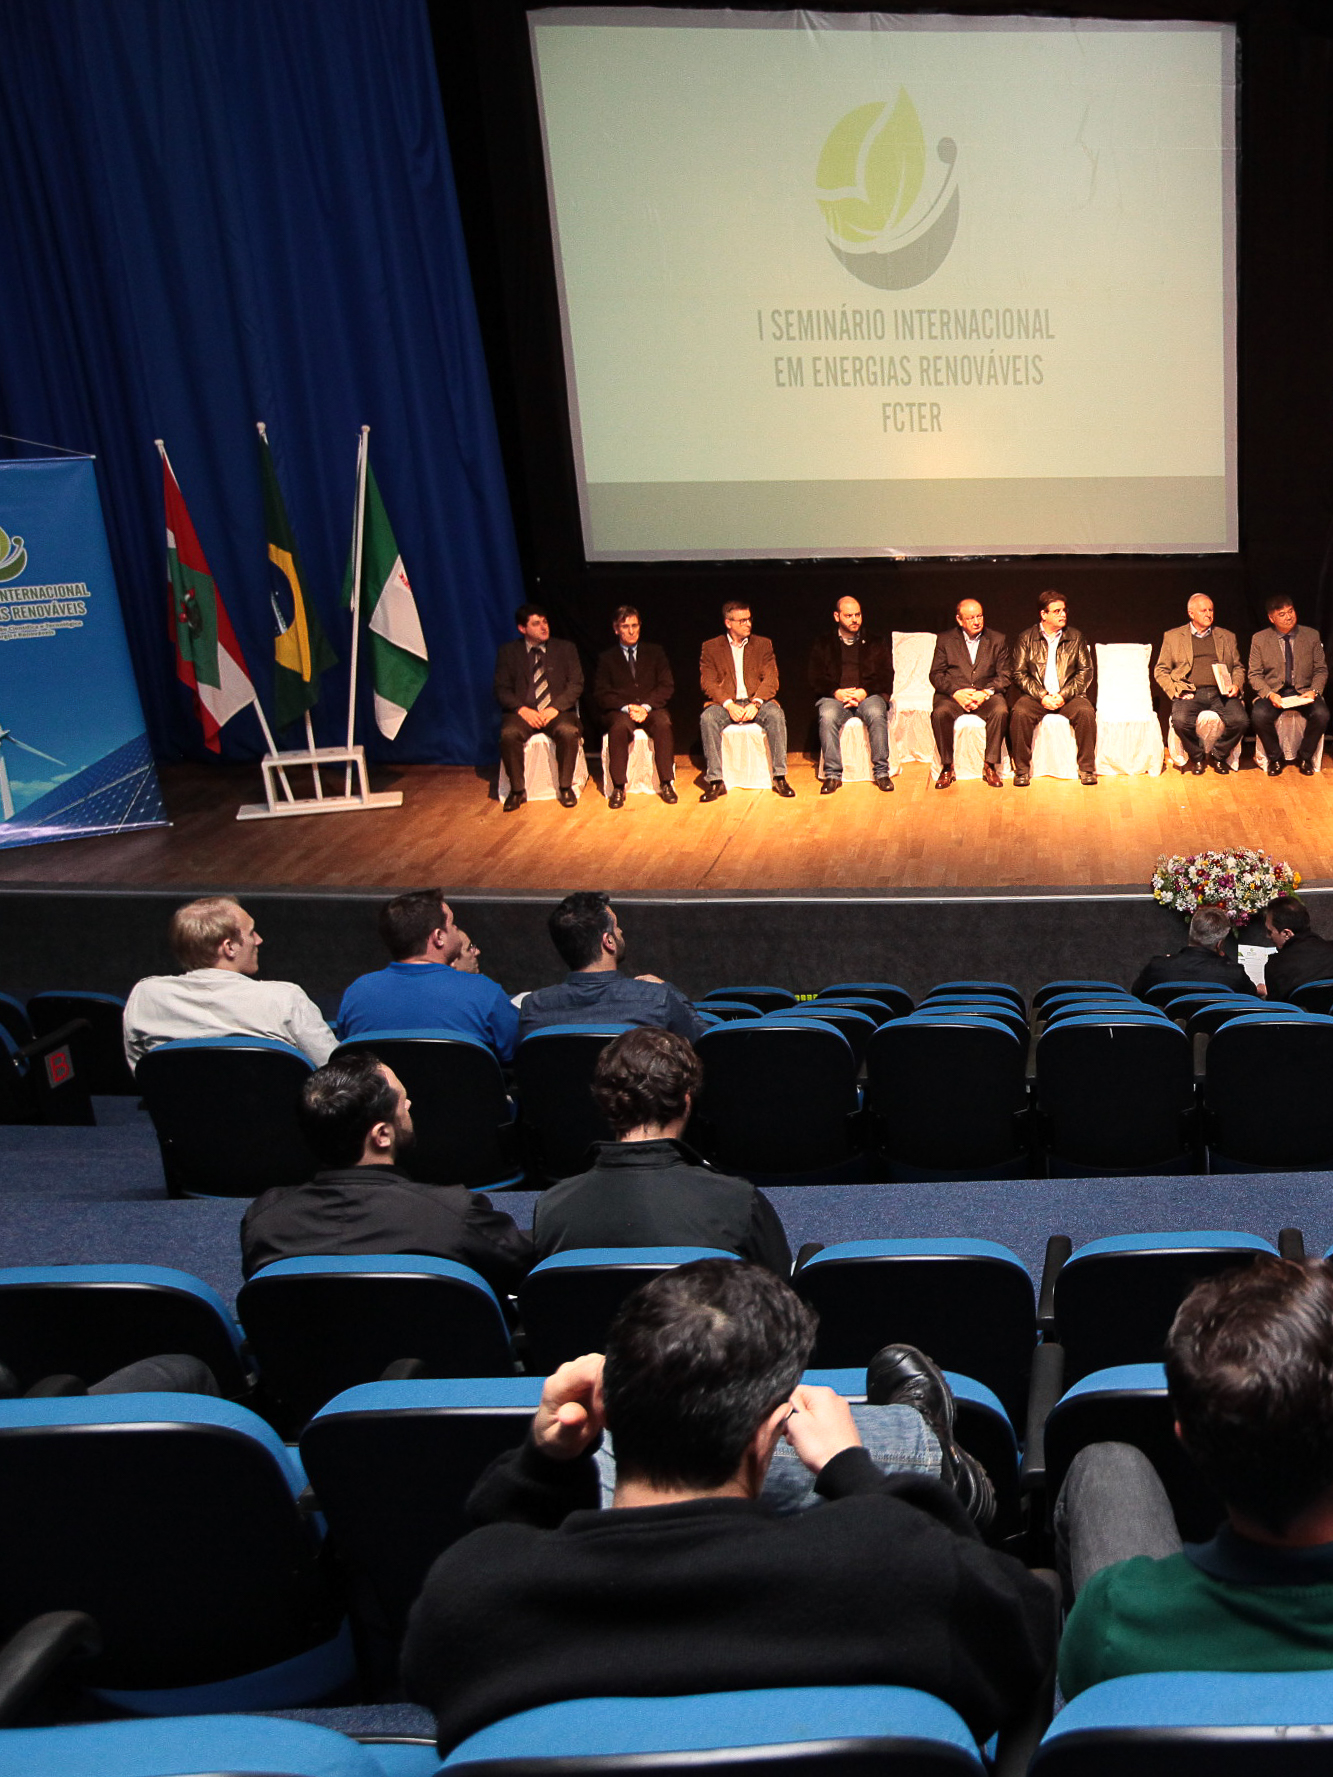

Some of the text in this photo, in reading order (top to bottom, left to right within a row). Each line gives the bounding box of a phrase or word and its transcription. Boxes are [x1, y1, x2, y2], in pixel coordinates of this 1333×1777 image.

[757, 303, 1056, 341] I SEMINÁRIO INTERNACIONAL
[774, 348, 1044, 387] EM ENERGIAS RENOVÁVEIS
[882, 402, 943, 433] FCTER
[0, 583, 90, 603] NTERNACIONAL
[11, 601, 87, 620] RENOVÁVEIS
[50, 1053, 70, 1083] B
